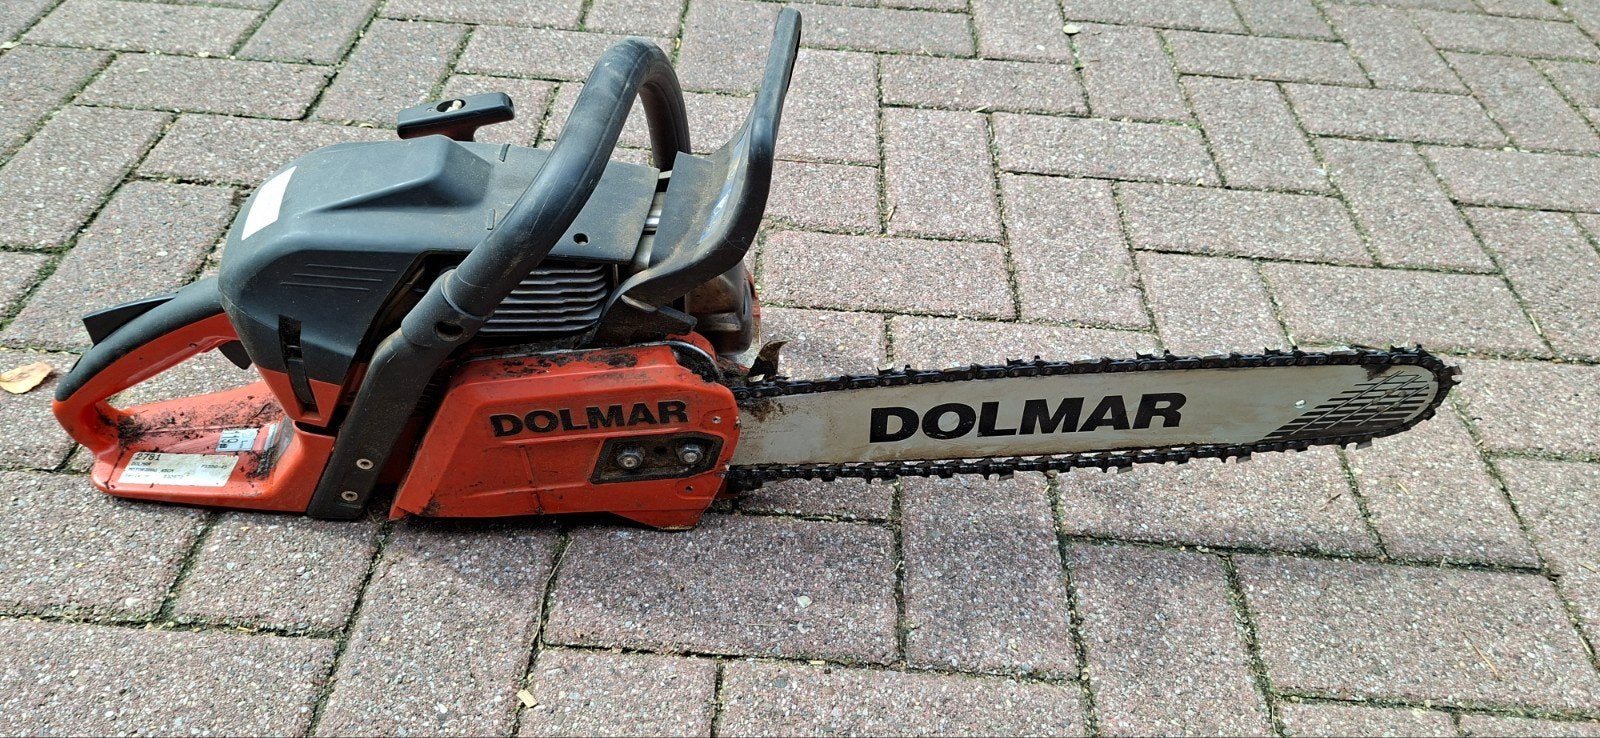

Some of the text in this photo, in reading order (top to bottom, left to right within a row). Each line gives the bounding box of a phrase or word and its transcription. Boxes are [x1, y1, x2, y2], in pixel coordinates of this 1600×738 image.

[489, 400, 690, 438] DOLMAR
[869, 392, 1187, 443] DOLMAR
[134, 452, 161, 461] 2781
